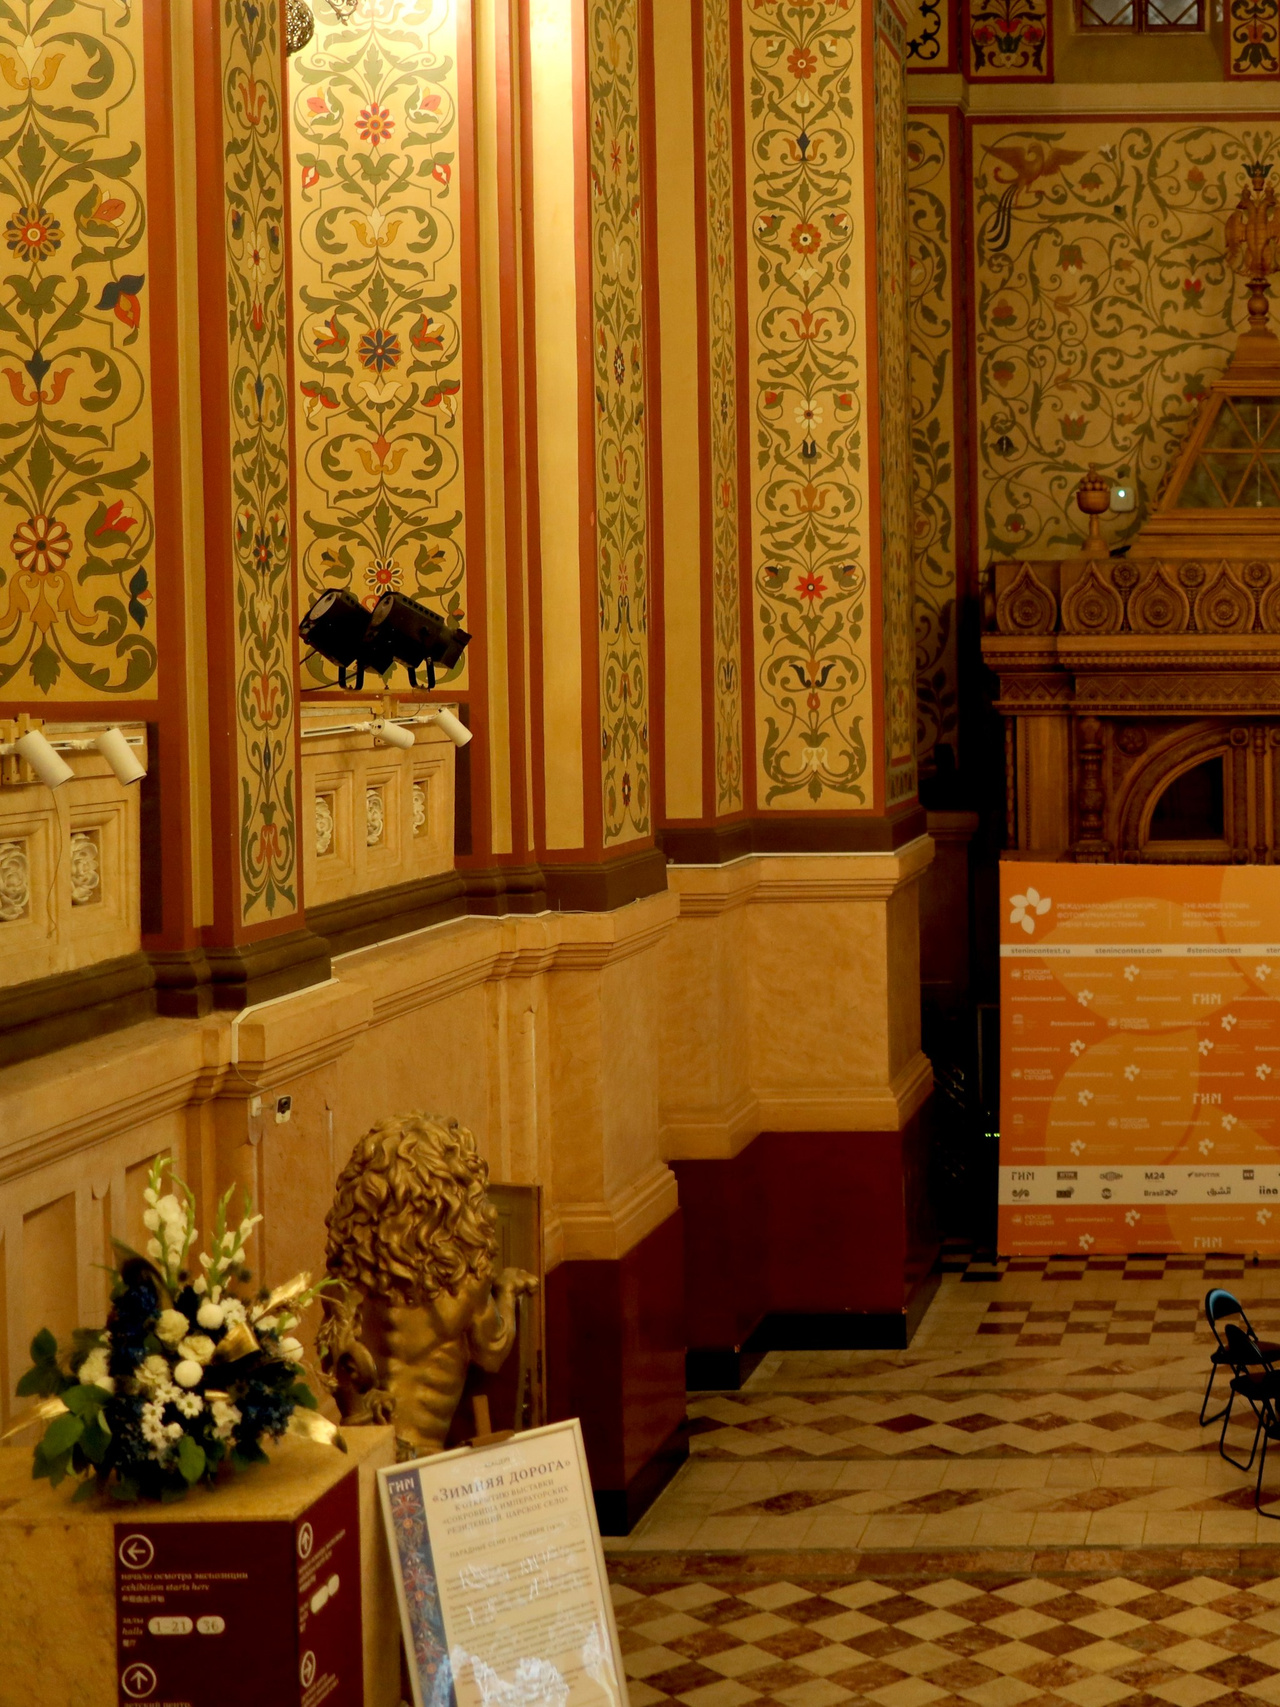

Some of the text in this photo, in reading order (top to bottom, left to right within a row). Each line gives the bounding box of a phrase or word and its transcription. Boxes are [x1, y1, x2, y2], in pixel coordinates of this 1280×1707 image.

[1010, 947, 1071, 955] stenincontest.ru
[1094, 947, 1163, 955] stenincontest.com
[1186, 946, 1242, 954] #stenincontest
[388, 1477, 416, 1495] ГИМ
